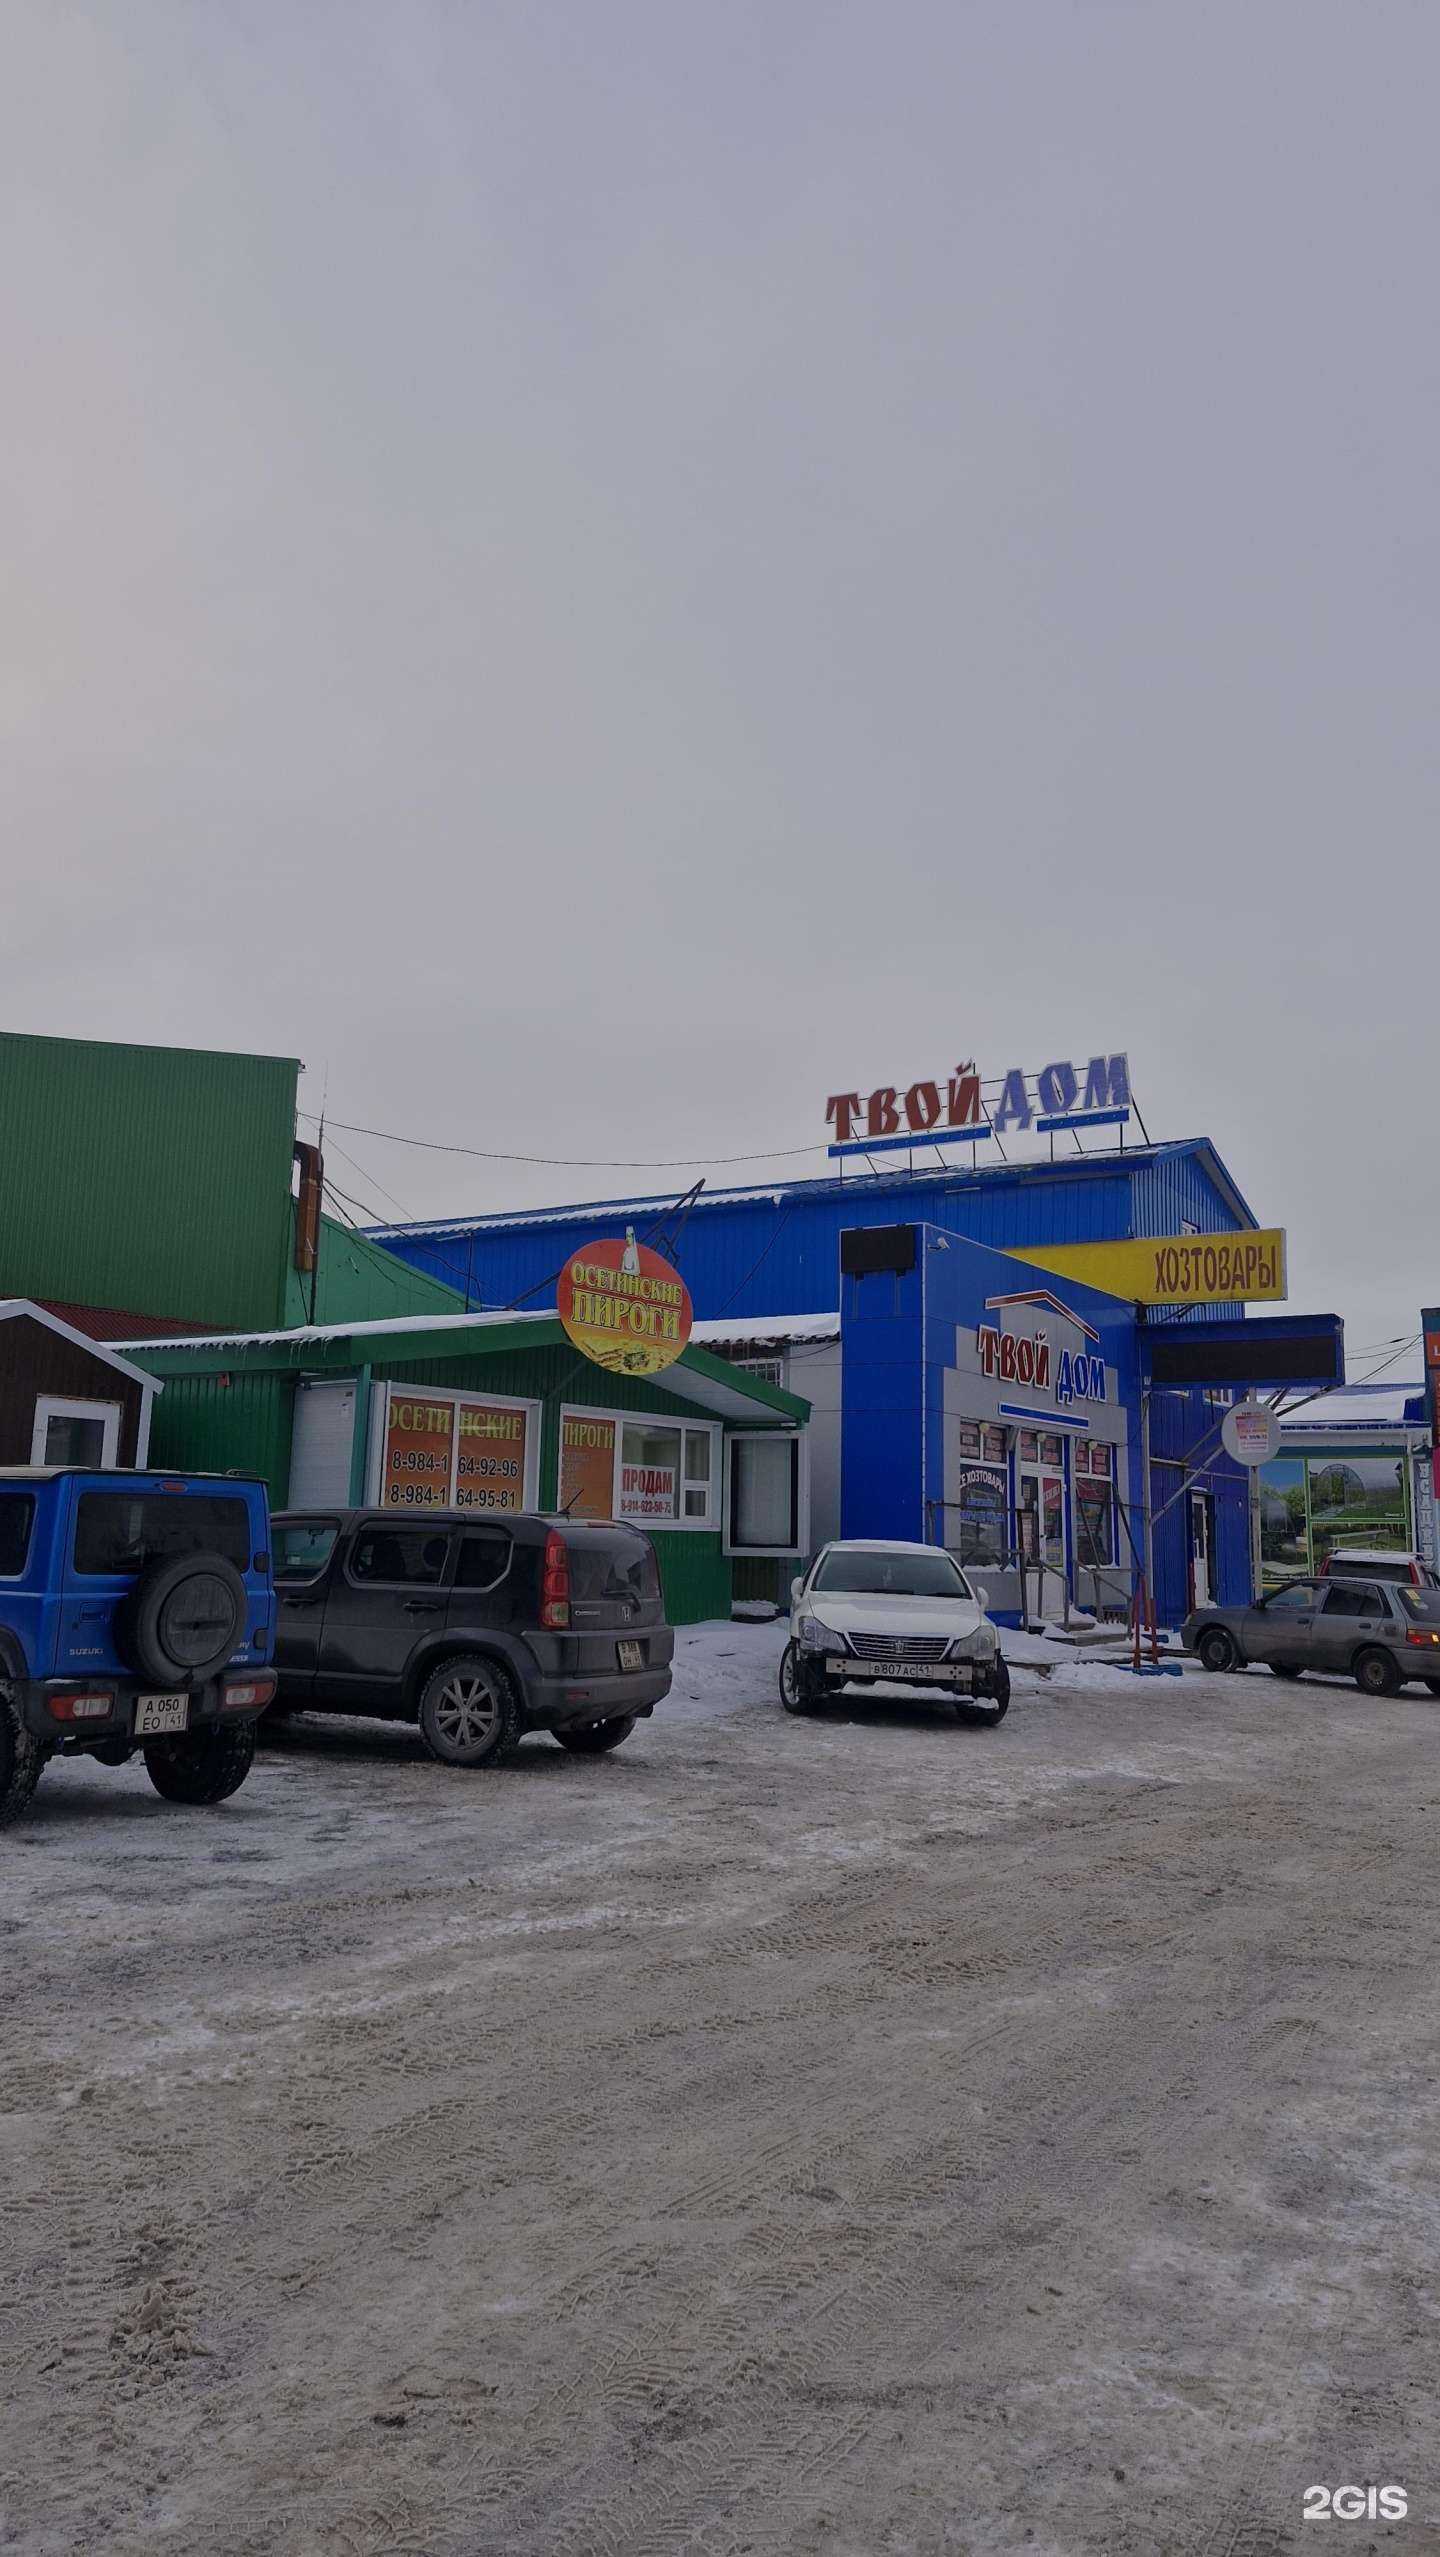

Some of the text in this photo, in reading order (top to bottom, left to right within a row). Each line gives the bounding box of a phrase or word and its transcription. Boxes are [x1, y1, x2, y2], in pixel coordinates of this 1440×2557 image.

[825, 1051, 1132, 1142] ТВОЙ ДОМ
[571, 1260, 683, 1306] ОСЕТИНСКИЕ
[1154, 1244, 1277, 1294] ХОЗТОВАРЫ
[570, 1287, 682, 1343] ПИРОГИ
[977, 1323, 1107, 1406] ТВОЙ ДОМ
[622, 1466, 673, 1498] ПРОДАМ
